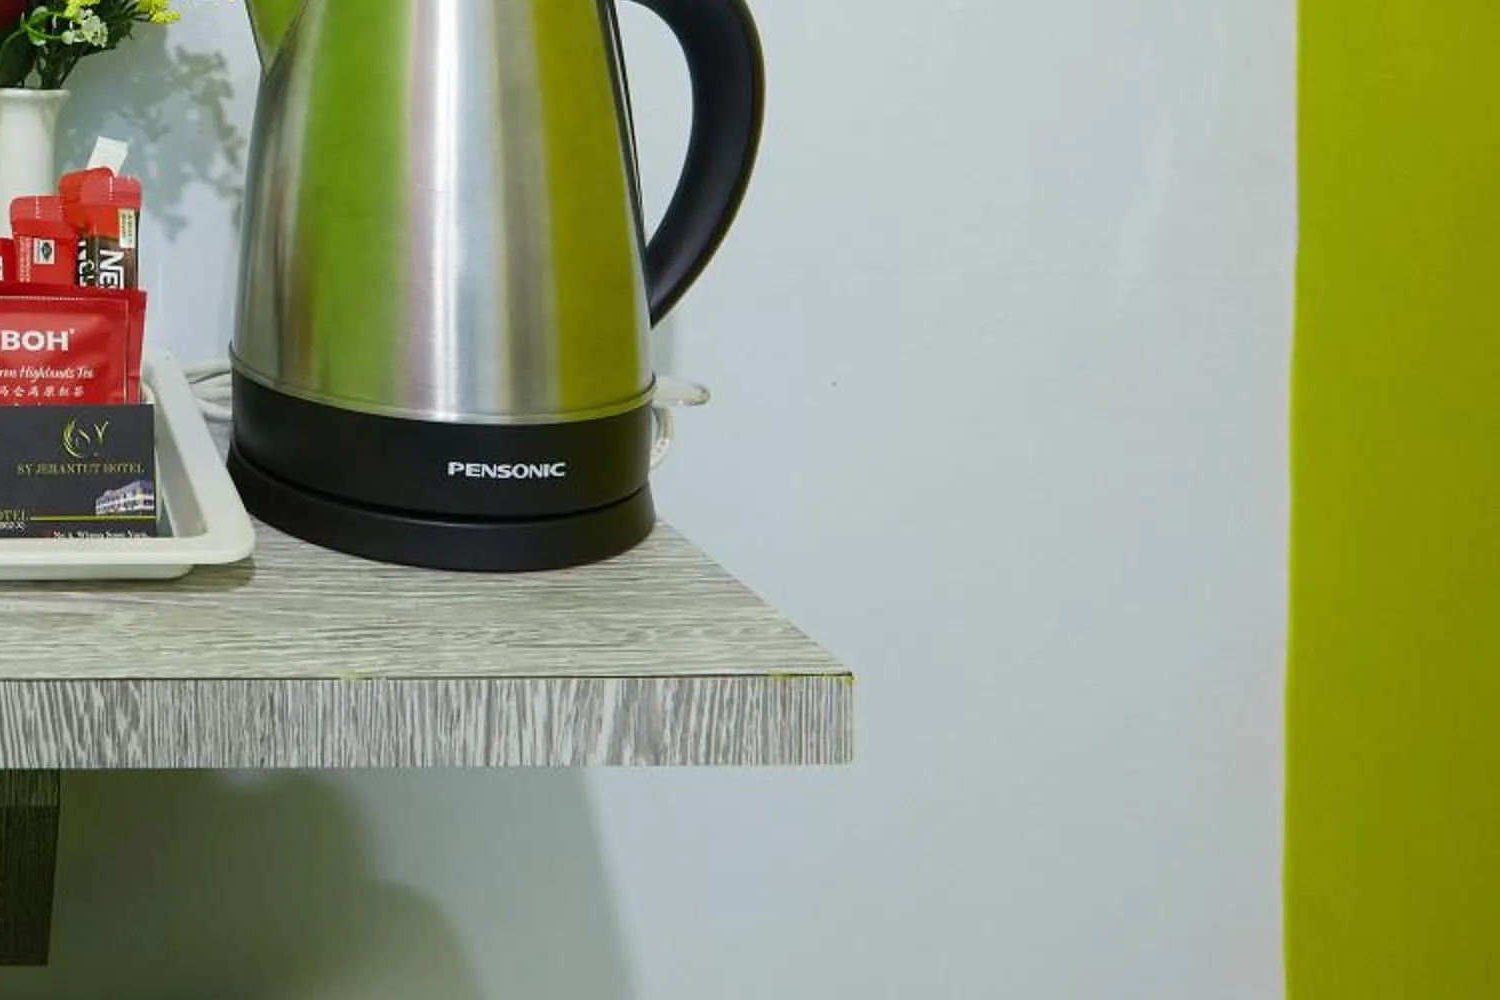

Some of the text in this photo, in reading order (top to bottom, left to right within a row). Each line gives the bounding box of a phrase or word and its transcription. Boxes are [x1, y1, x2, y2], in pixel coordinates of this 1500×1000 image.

[19, 364, 75, 383] Highlands
[77, 365, 95, 379] Tea
[16, 463, 145, 475] SY JERANTUT HOTEL
[447, 461, 567, 479] PENSONIC
